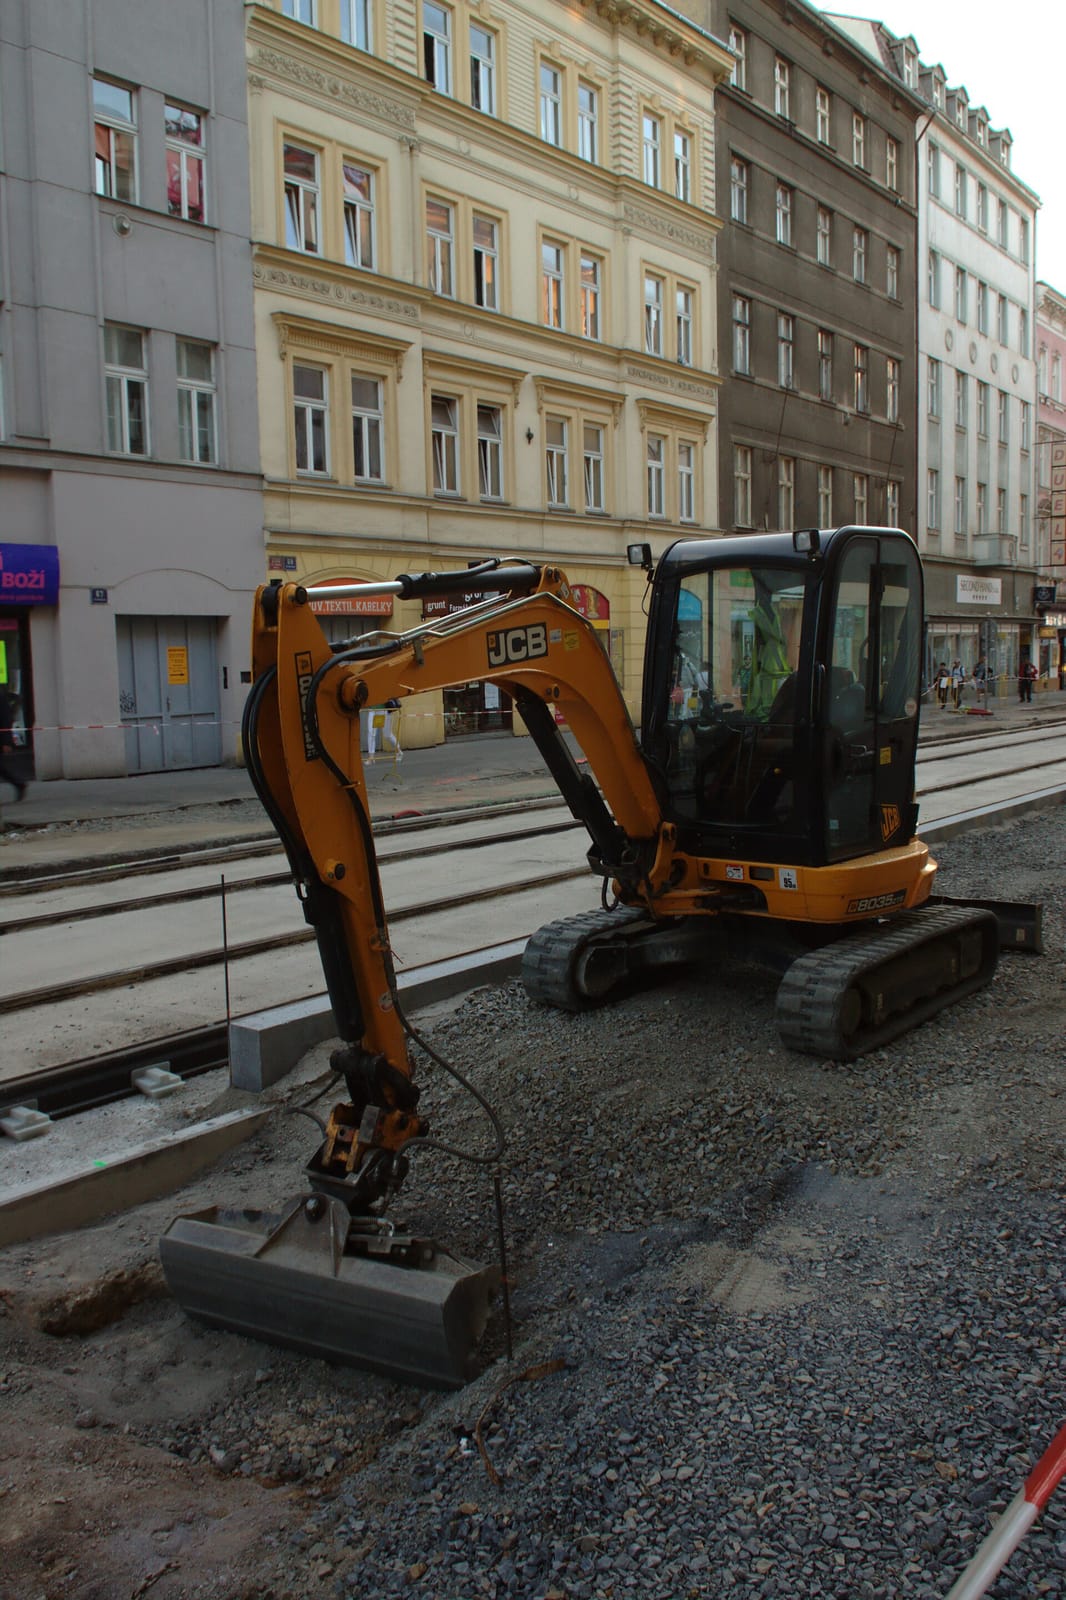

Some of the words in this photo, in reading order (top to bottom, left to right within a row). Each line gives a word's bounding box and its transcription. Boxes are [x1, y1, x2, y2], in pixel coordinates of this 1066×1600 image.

[2, 569, 45, 589] BOŽÍ
[489, 625, 547, 665] JCB
[881, 806, 900, 841] JCB
[783, 877, 793, 889] 95
